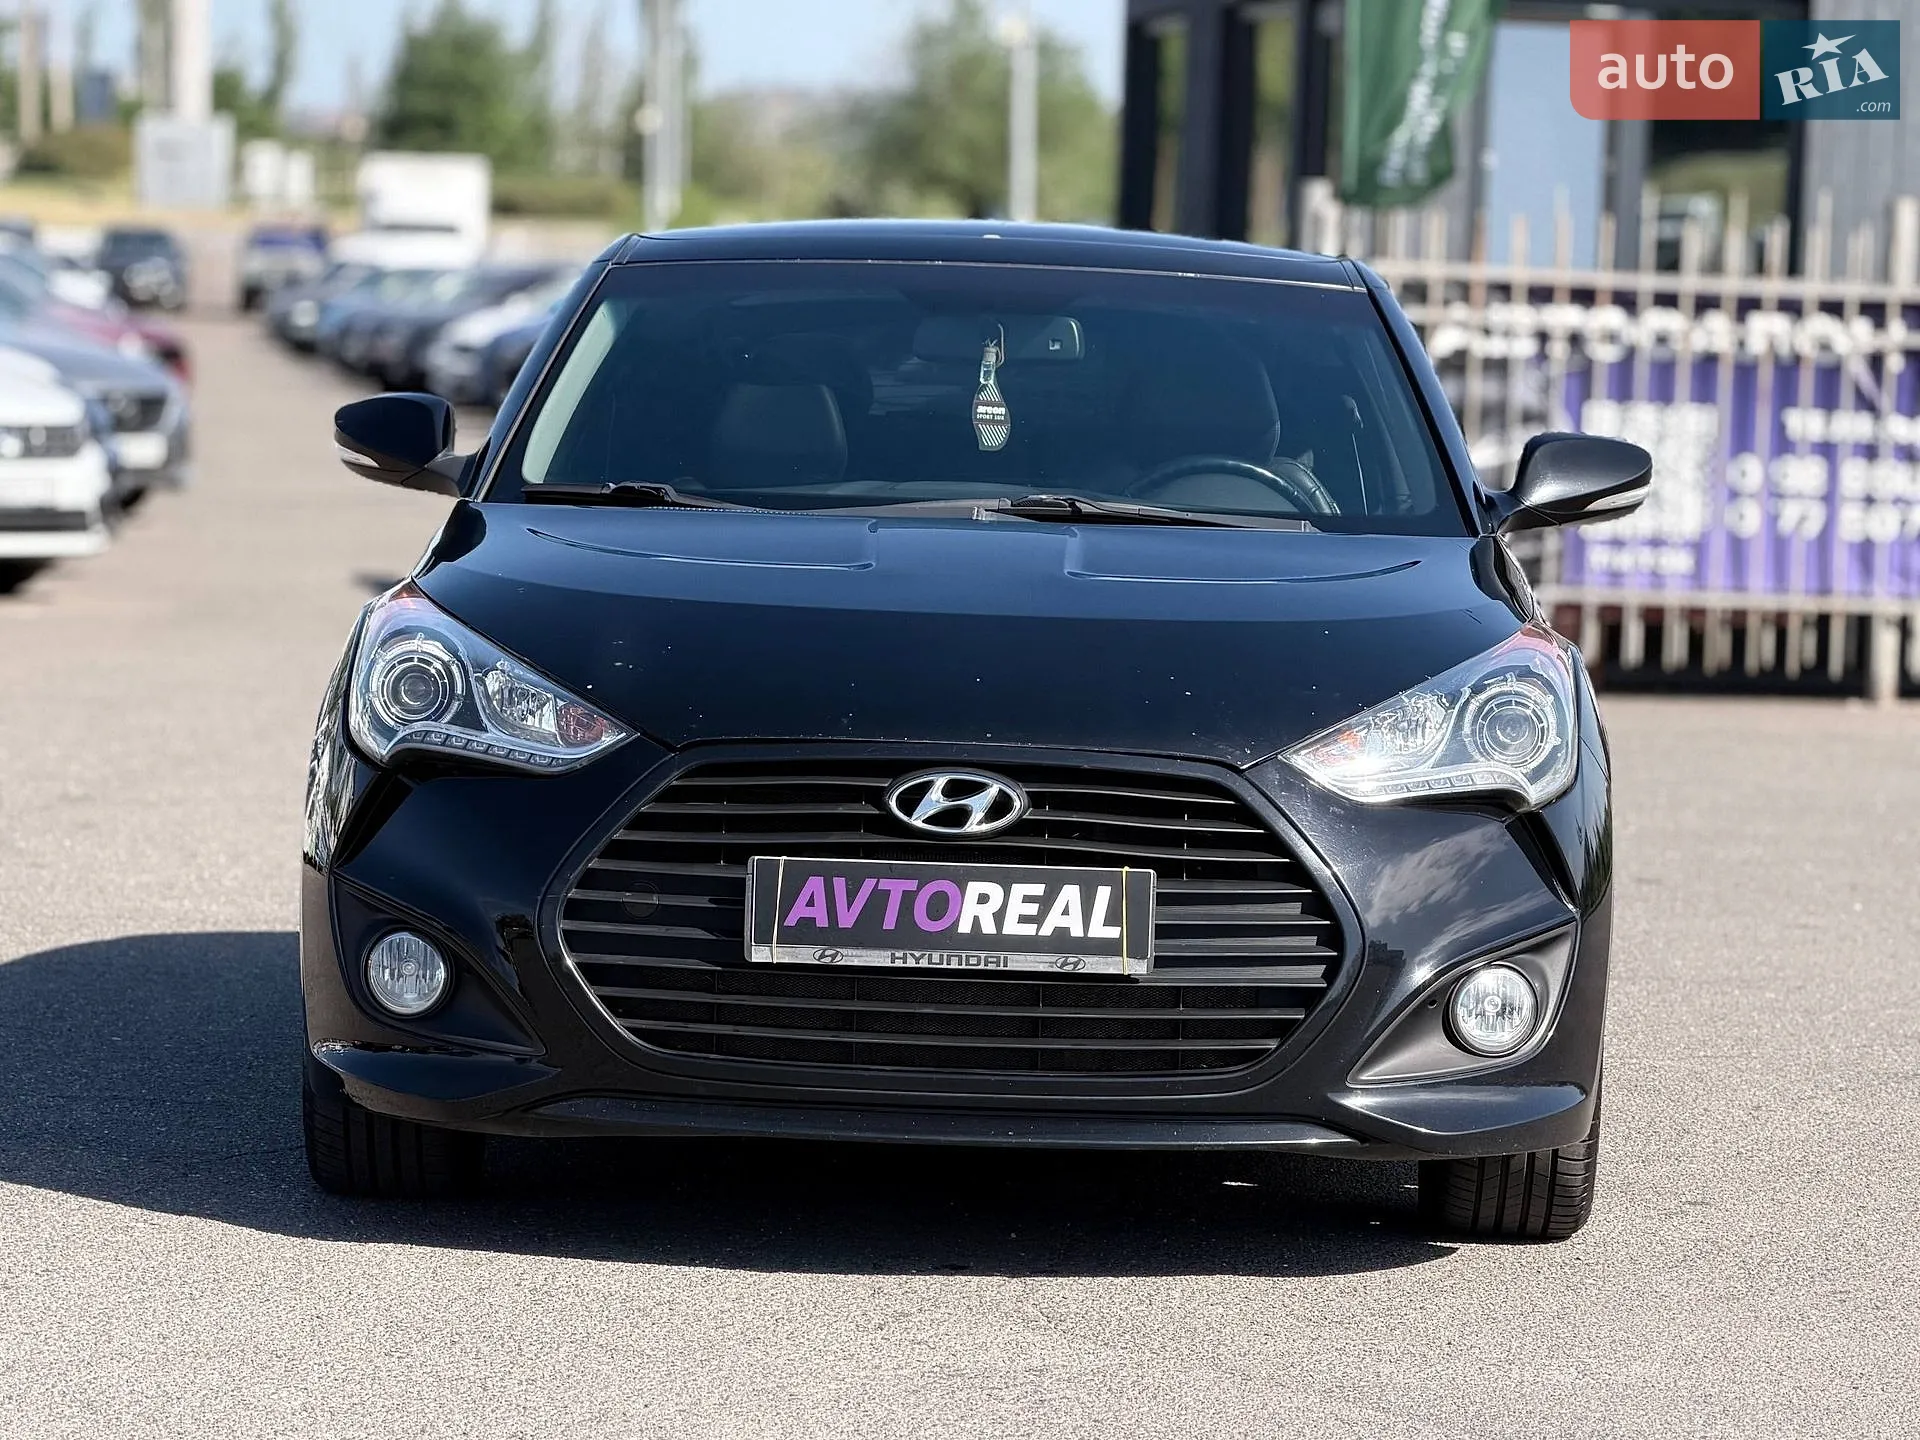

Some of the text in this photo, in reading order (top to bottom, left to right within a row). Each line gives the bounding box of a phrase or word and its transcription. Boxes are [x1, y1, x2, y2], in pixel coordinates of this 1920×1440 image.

[976, 405, 1006, 415] areon
[783, 875, 1122, 939] AVTOREAL
[890, 951, 1009, 968] HYUNDAI
